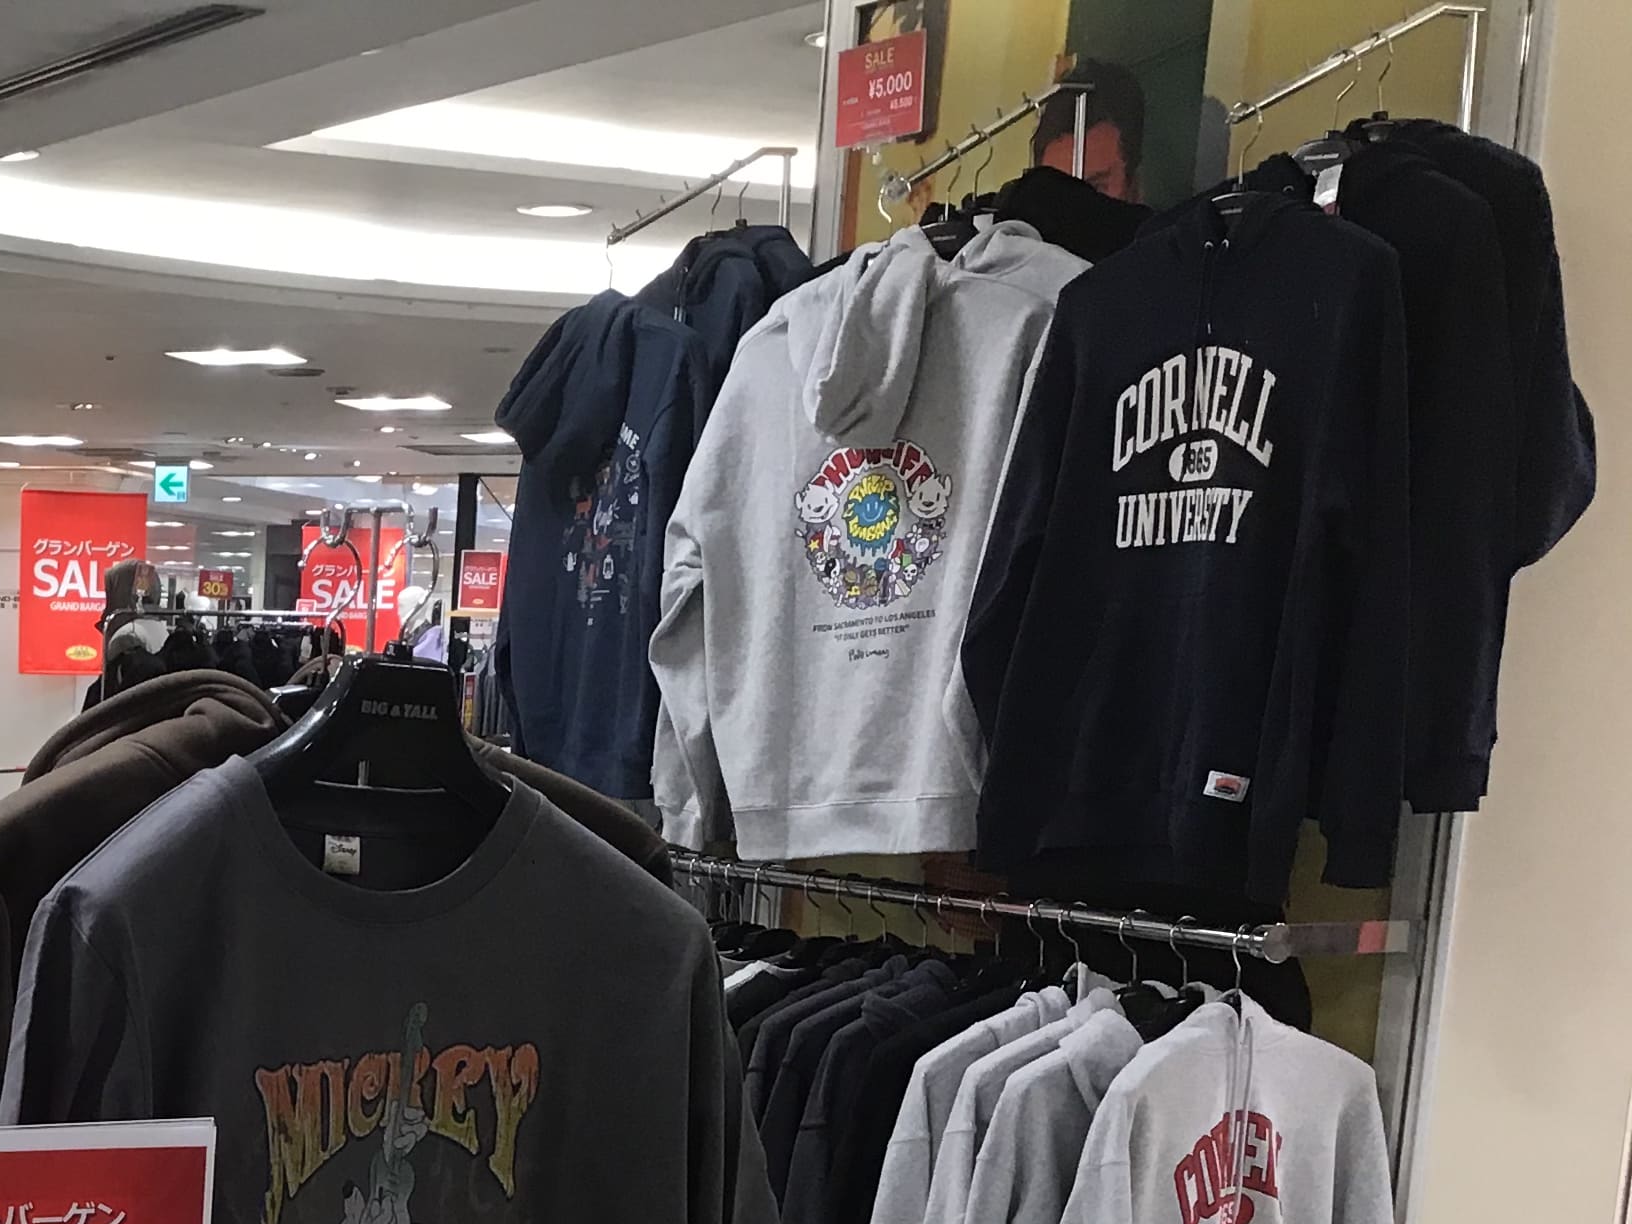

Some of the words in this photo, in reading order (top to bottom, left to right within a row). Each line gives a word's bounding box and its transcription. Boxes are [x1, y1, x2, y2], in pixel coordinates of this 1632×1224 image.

[865, 47, 895, 69] SALE
[1113, 346, 1276, 472] CORNELL
[33, 538, 135, 557] グランバーゲン
[464, 572, 497, 585] SALE
[312, 579, 396, 609] SALE
[50, 601, 80, 612] GRAND
[884, 614, 899, 623] LOS
[899, 609, 936, 621] ANGELES
[361, 701, 389, 715] BIG
[403, 704, 438, 720] TALL
